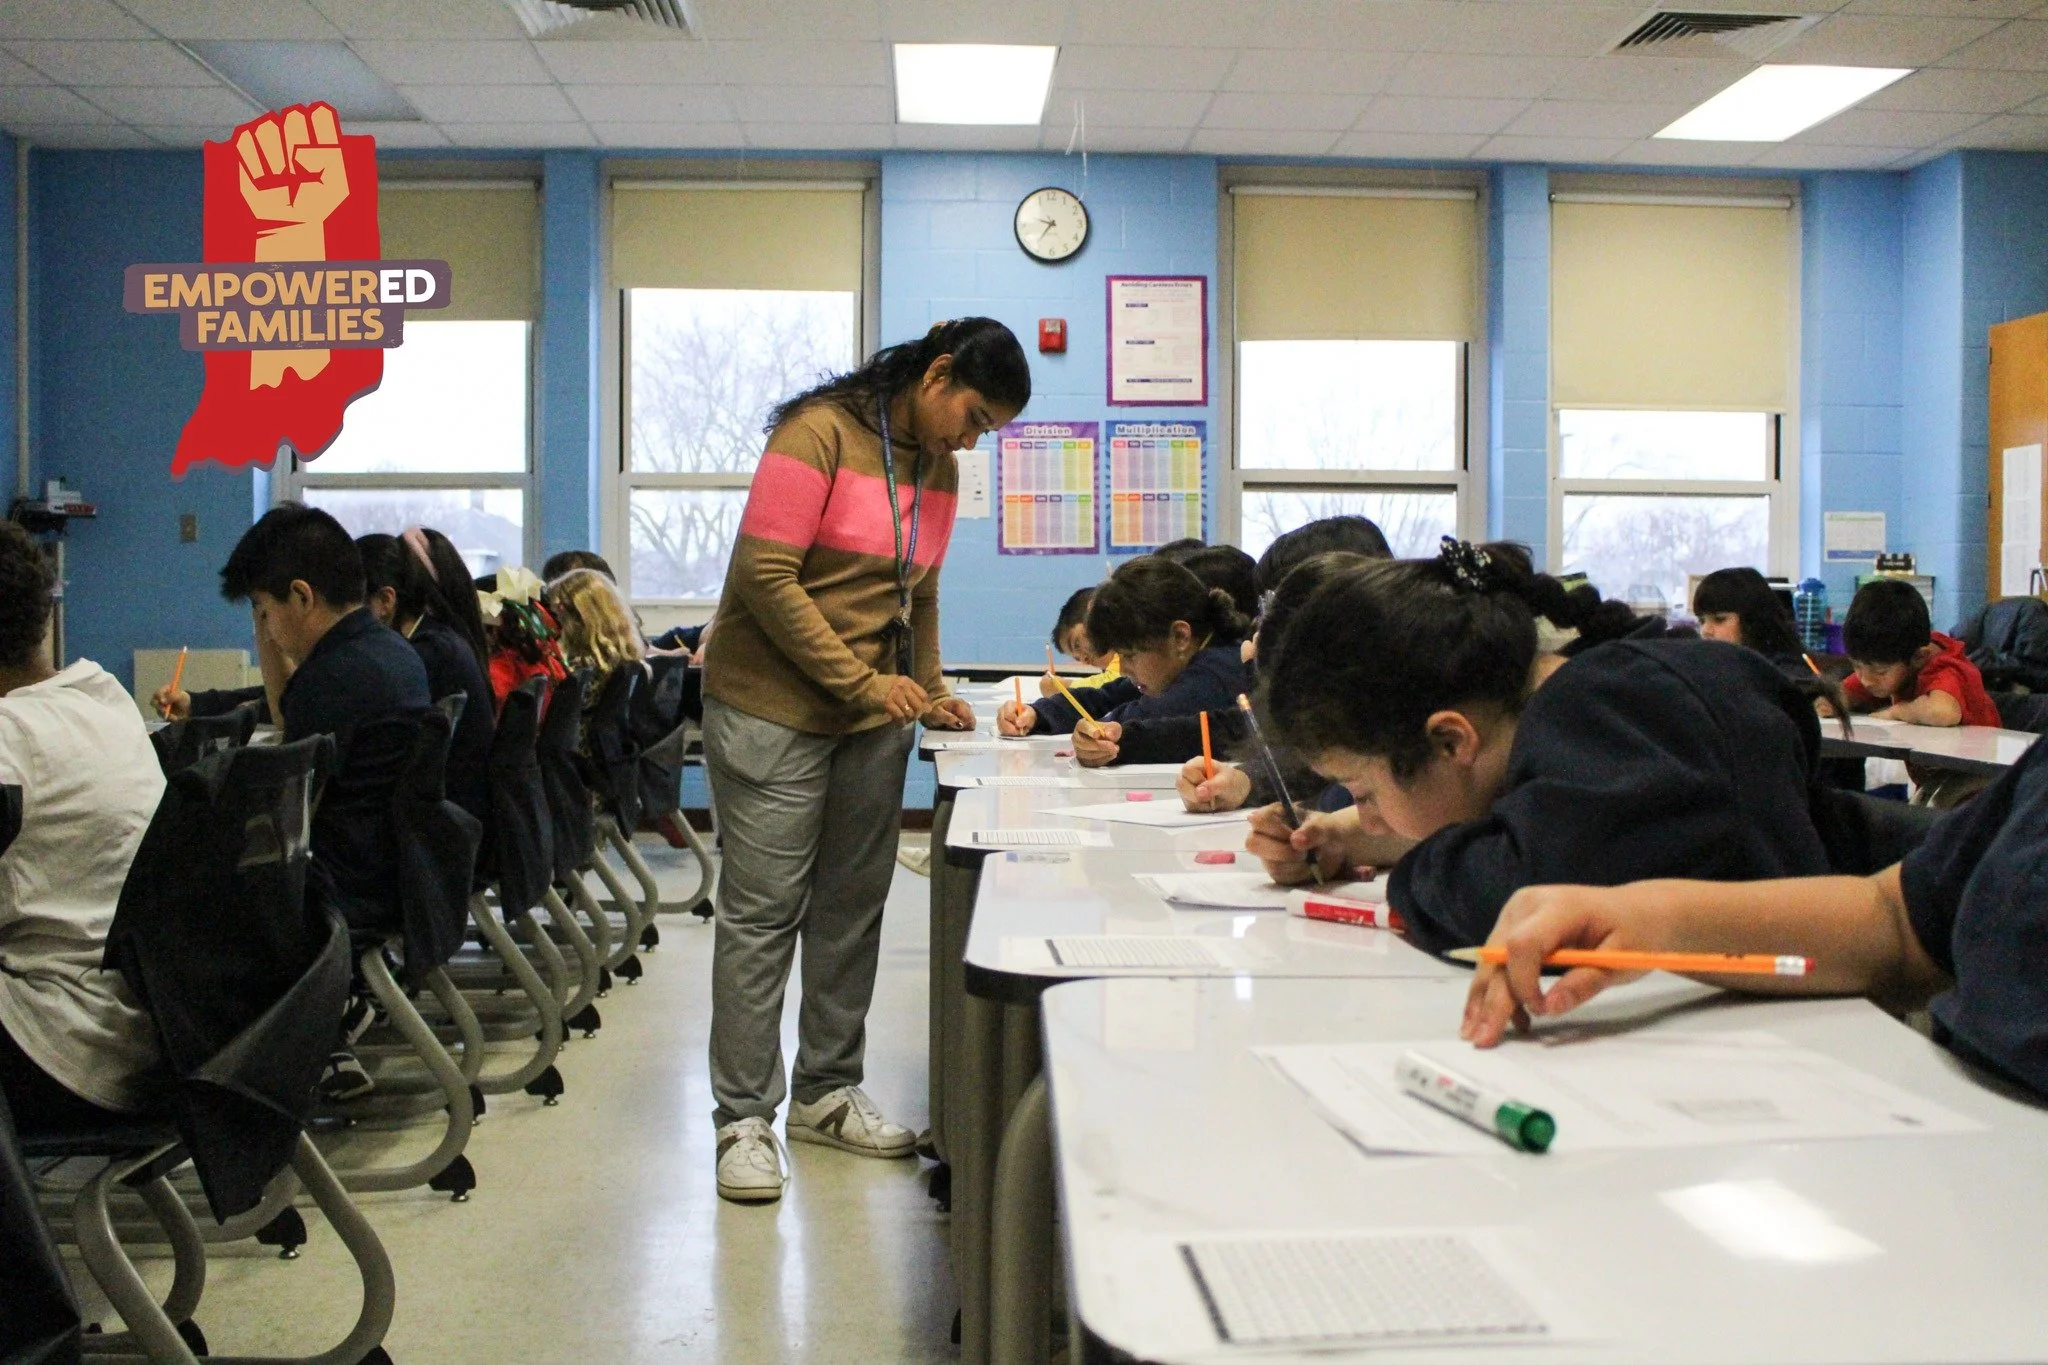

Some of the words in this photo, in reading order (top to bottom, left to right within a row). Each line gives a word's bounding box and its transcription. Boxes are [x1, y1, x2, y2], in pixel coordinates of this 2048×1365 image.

[1046, 190, 1056, 201] 12
[1072, 205, 1078, 216] 2
[1049, 247, 1056, 257] 6
[1062, 243, 1069, 253] 5
[1026, 426, 1070, 435] Division
[1117, 425, 1195, 435] Multiplication
